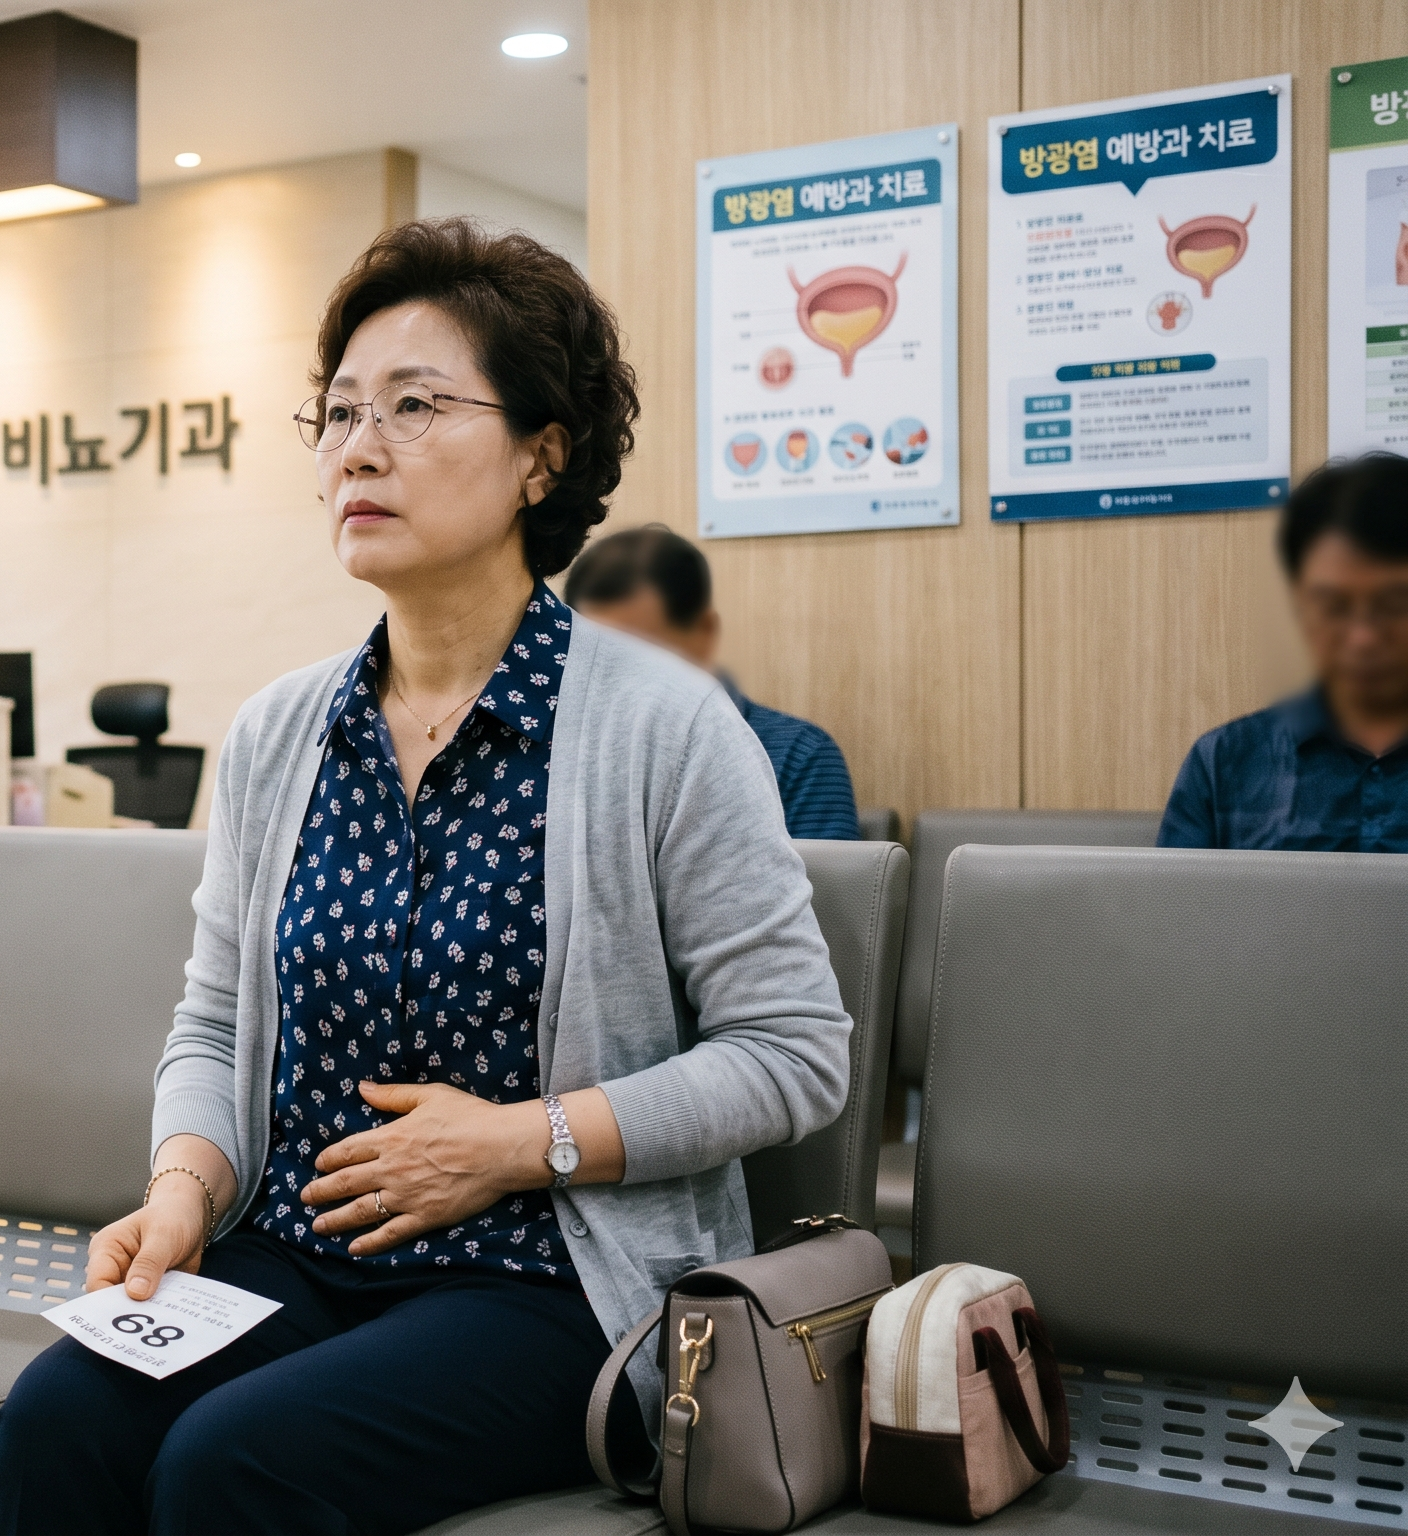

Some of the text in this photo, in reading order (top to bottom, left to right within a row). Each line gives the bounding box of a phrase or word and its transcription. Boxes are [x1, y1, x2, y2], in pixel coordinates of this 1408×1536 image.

[1370, 90, 1408, 126] 방
[1019, 117, 1256, 179] 방광염 예방과 치료
[723, 169, 928, 224] 방광염 예방과 치료
[2, 395, 240, 487] 비뇨기과
